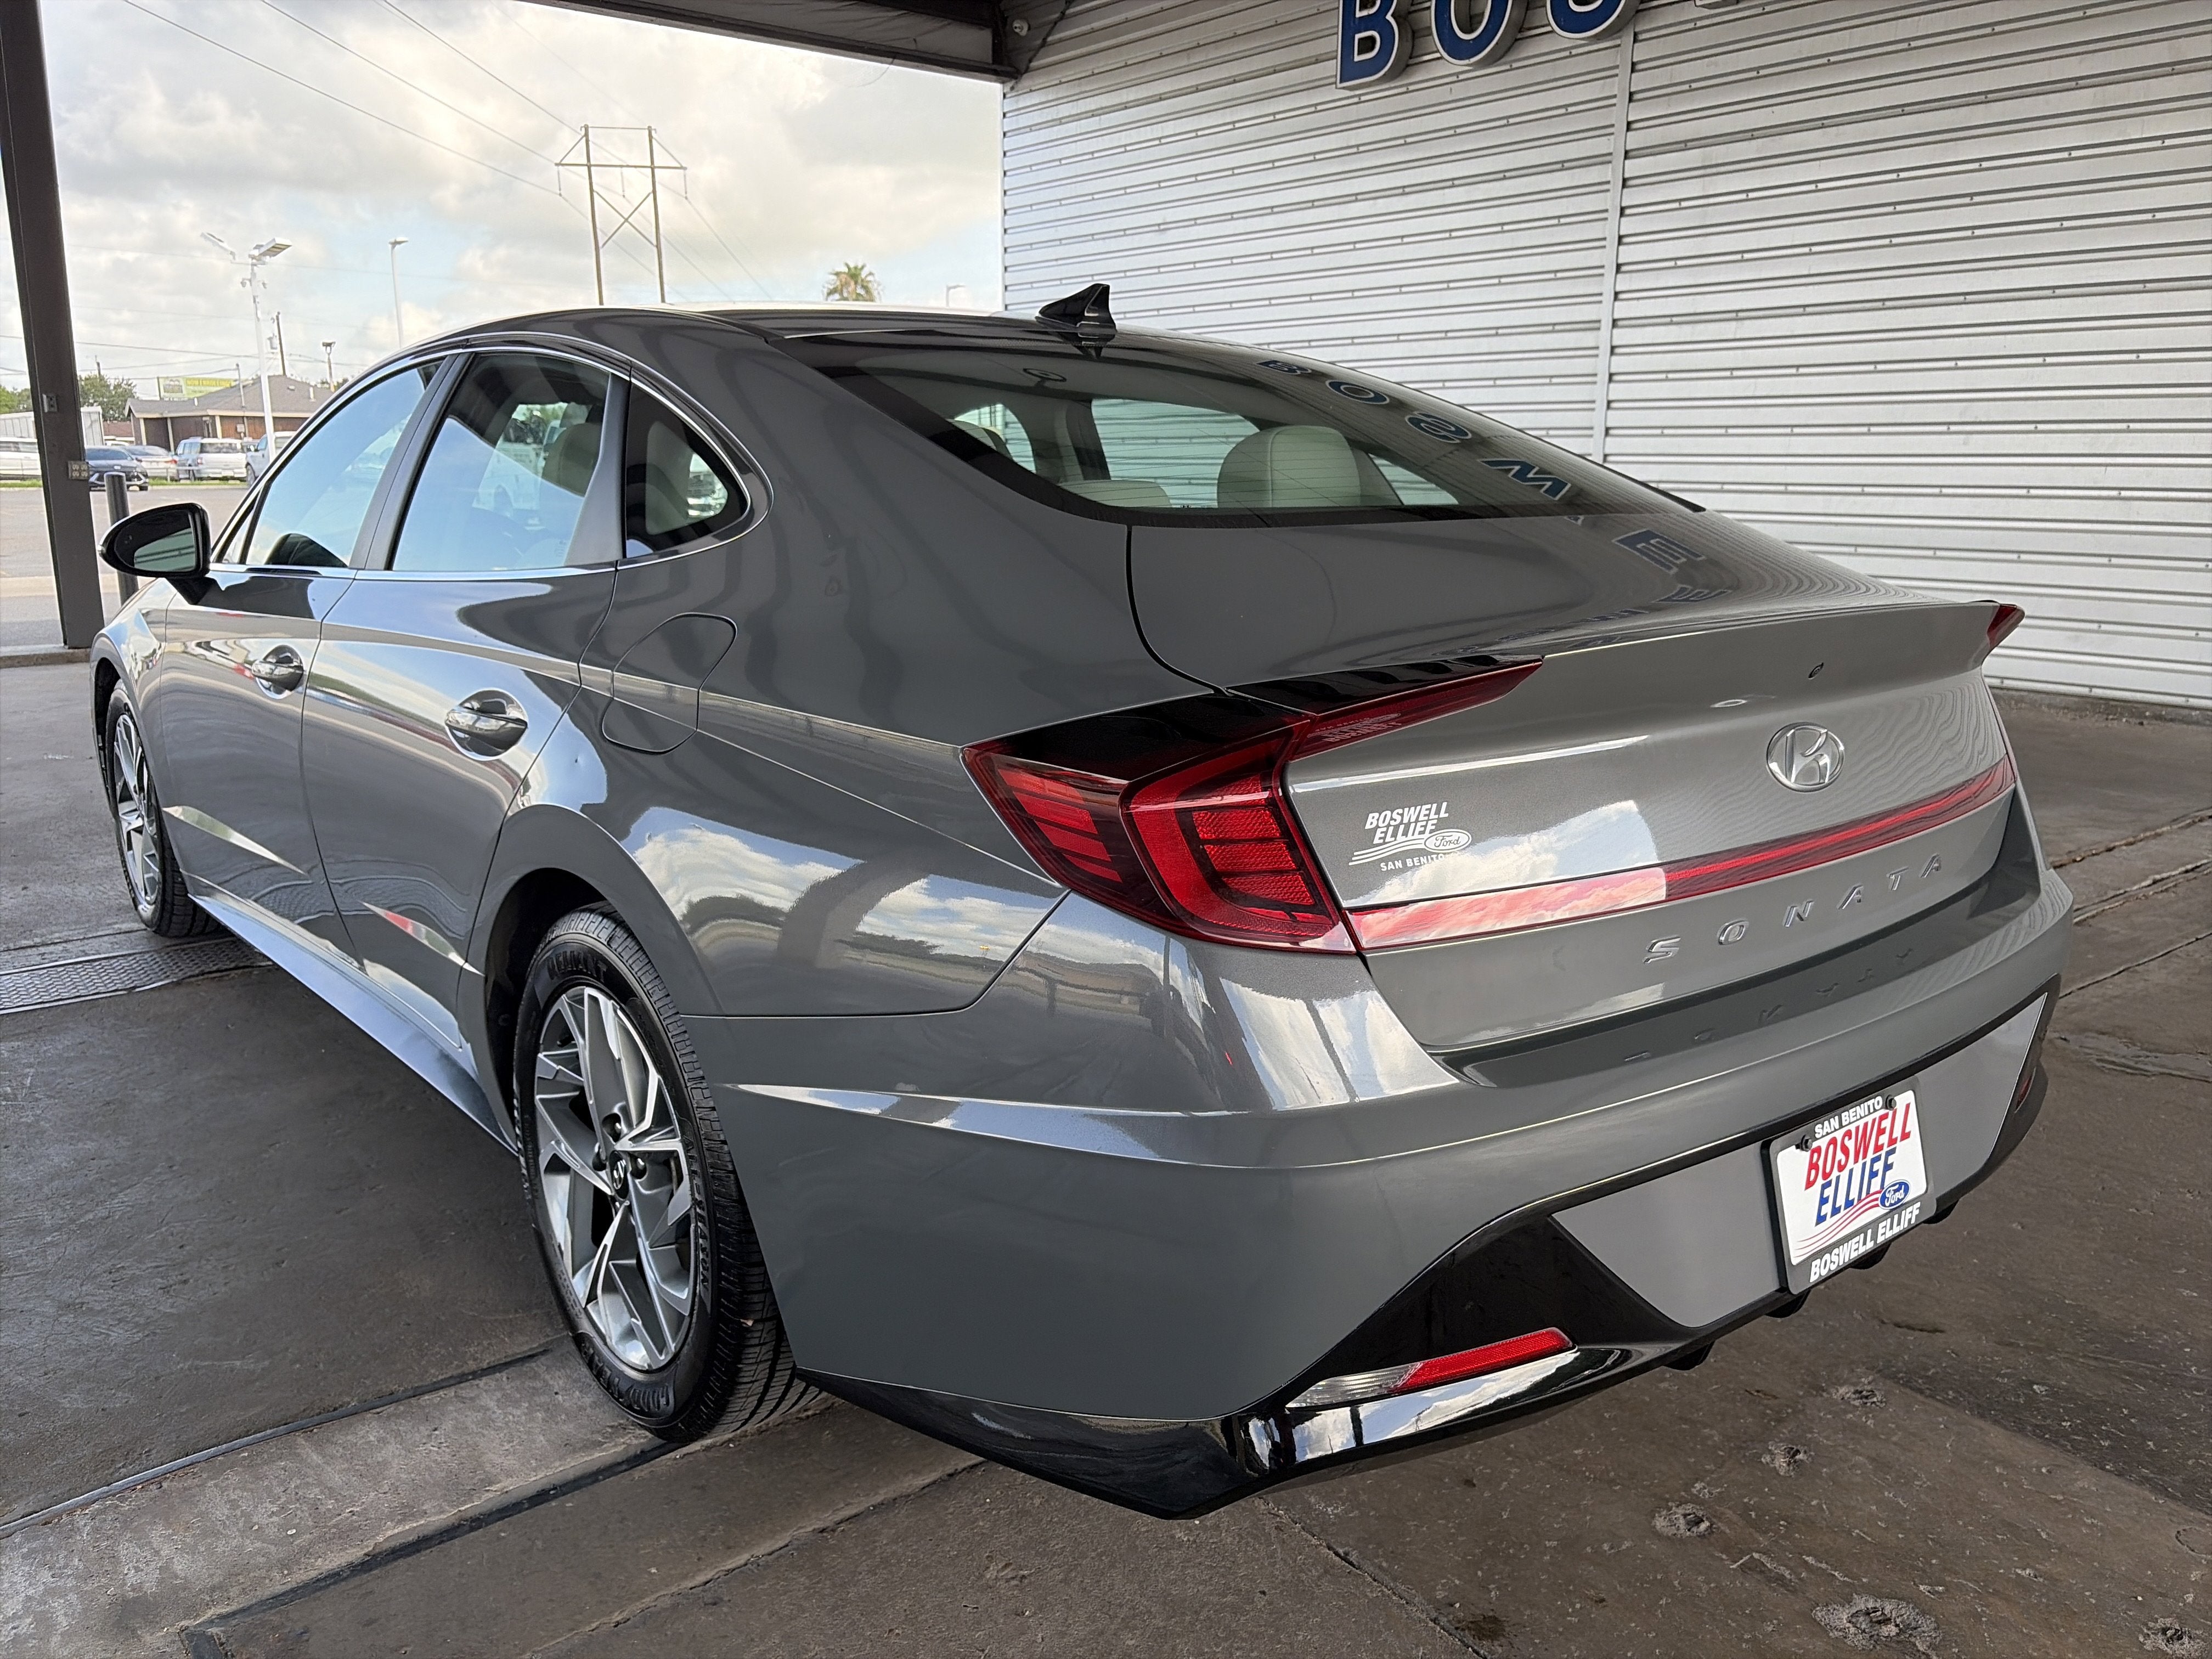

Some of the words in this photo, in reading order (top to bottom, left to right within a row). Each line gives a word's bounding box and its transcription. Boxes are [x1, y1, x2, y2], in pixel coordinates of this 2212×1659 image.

[1365, 802, 1449, 830] BOSWELL
[1373, 820, 1437, 844] ELLIFF
[1434, 834, 1462, 848] Ford
[1380, 860, 1403, 871] SAN
[1406, 854, 1444, 867] BENITO
[1643, 853, 1942, 964] SONATA
[1814, 1116, 1839, 1139] SAN
[1842, 1096, 1883, 1127] BENITO
[1804, 1102, 1911, 1191] BOSWELL
[1814, 1146, 1897, 1227] ELLIFF
[1884, 1184, 1905, 1206] Ford
[1810, 1229, 1874, 1283] BOSWELL
[1877, 1201, 1920, 1244] ELLIFF
